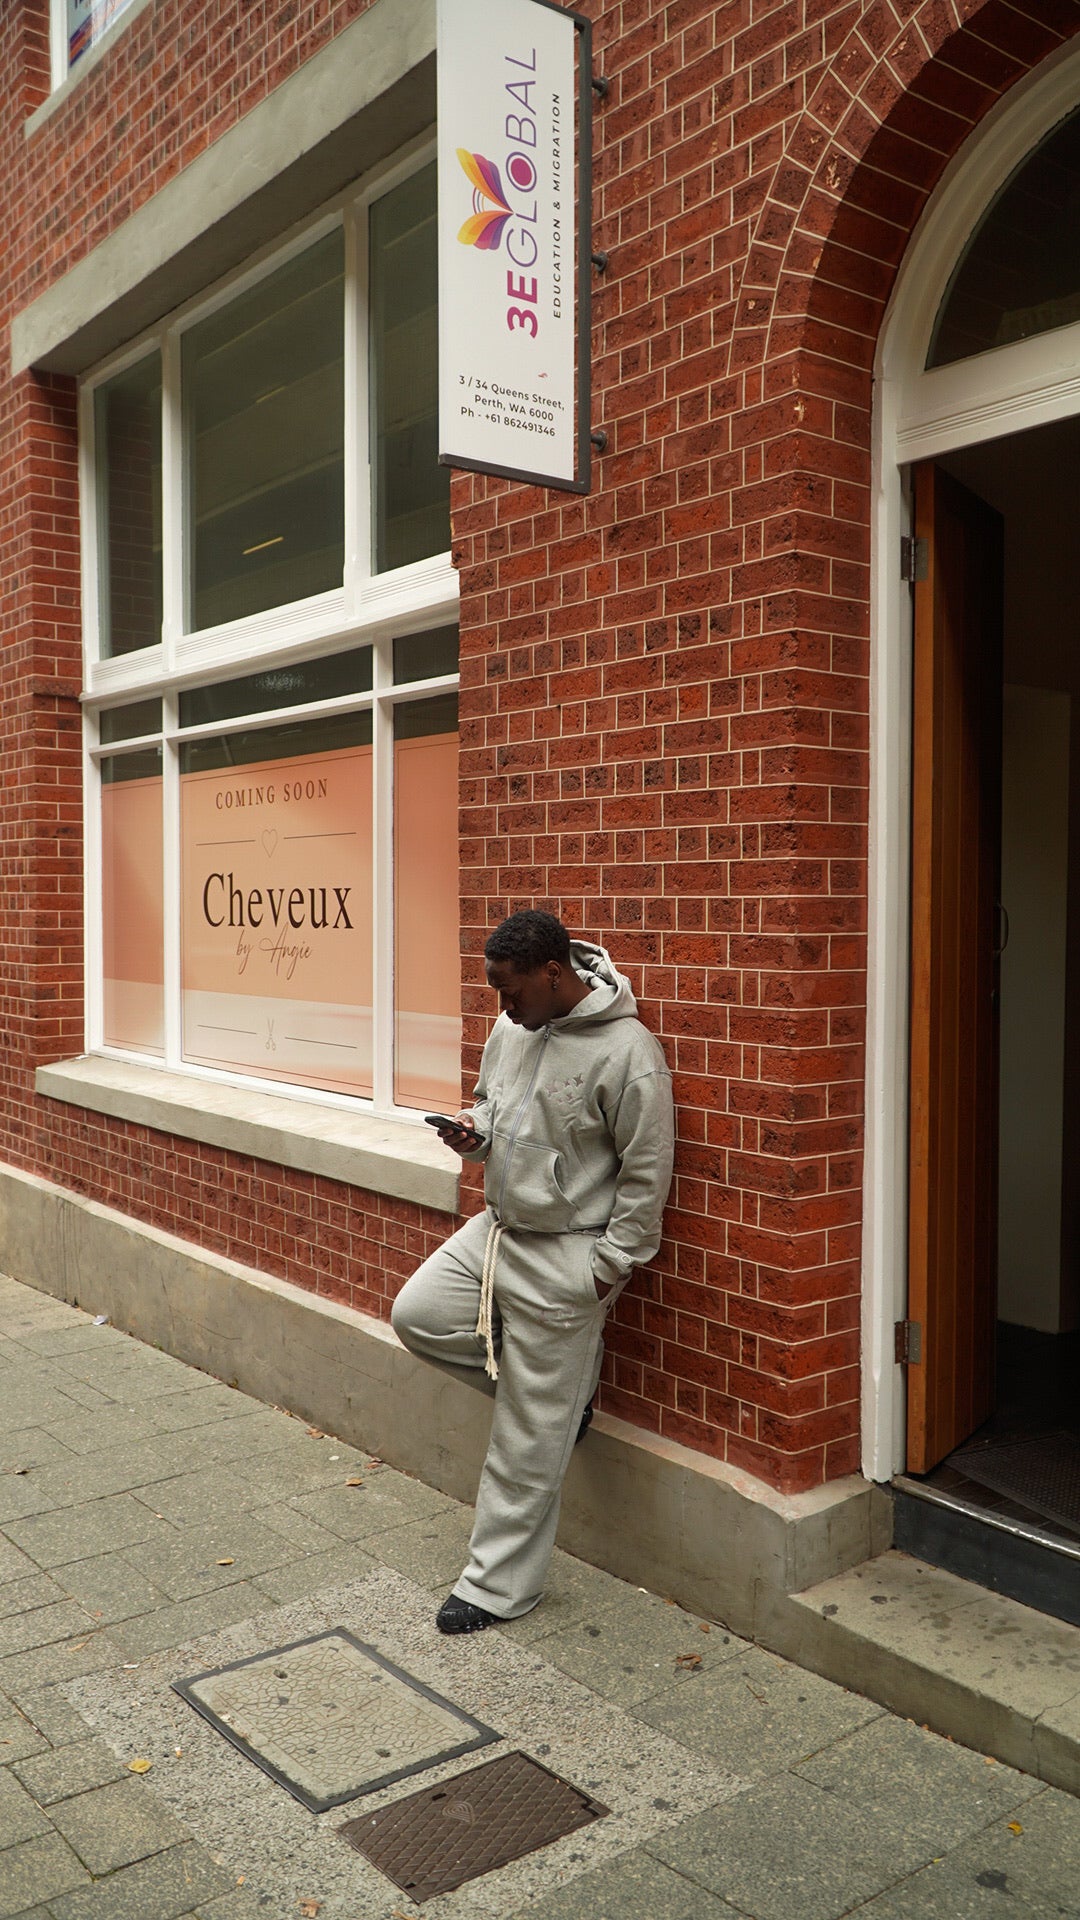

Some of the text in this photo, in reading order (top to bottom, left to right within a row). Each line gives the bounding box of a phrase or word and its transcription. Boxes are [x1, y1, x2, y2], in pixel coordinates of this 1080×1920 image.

[551, 93, 562, 319] EDUCATION & MIGRATION
[459, 375, 465, 385] 3
[475, 379, 488, 390] 34
[491, 383, 530, 401] Queens
[532, 393, 565, 411] Street,
[474, 394, 554, 422] Perth, WA 6000
[460, 406, 475, 418] Ph
[485, 413, 501, 424] +61
[503, 416, 556, 437] 862491346
[215, 778, 328, 810] COMING SOON
[203, 872, 354, 930] Cheveux
[236, 922, 313, 981] by Angie
